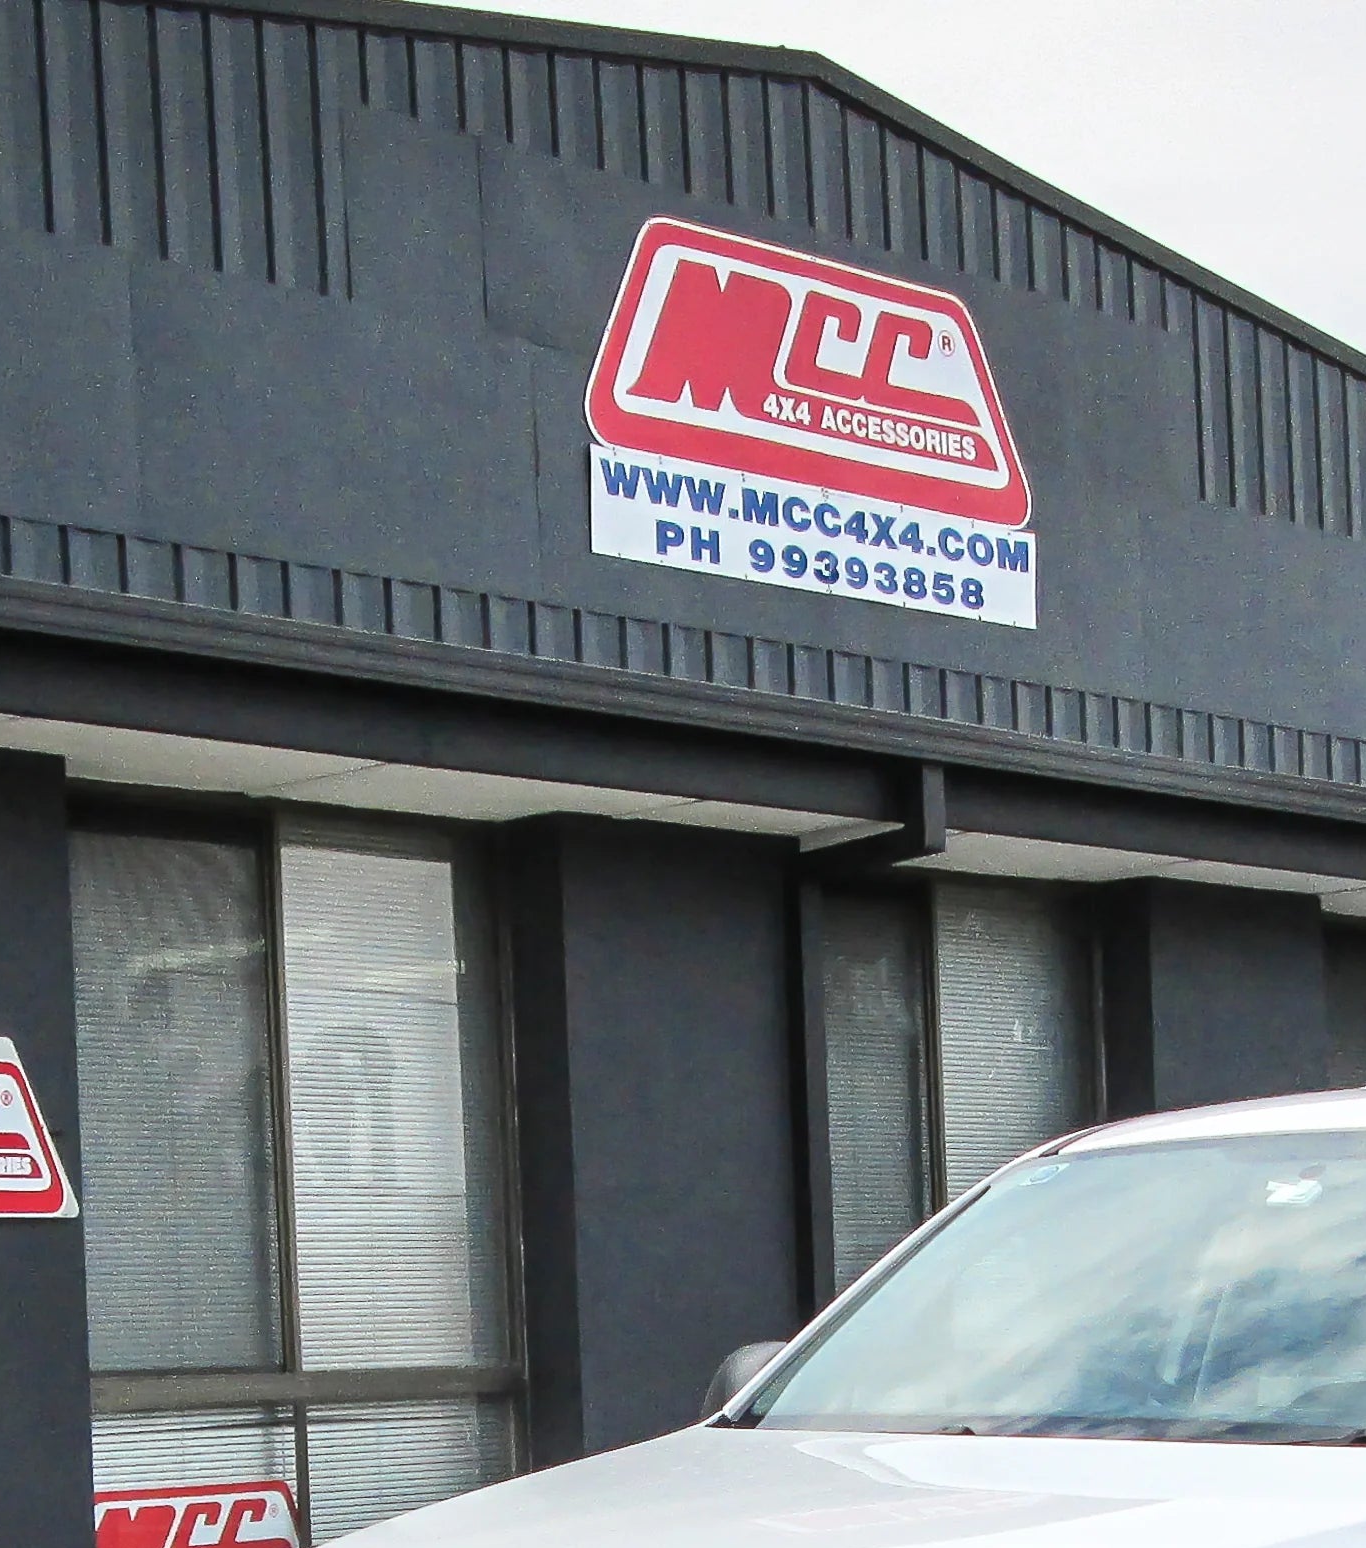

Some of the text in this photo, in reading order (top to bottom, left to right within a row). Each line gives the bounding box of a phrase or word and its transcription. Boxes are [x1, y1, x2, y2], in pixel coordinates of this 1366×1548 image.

[626, 258, 981, 426] MCC
[763, 392, 978, 461] 4X4 ACCESSORIES
[599, 458, 1030, 573] WWW.MCC4X4.COM
[656, 520, 986, 610] PH 99393858
